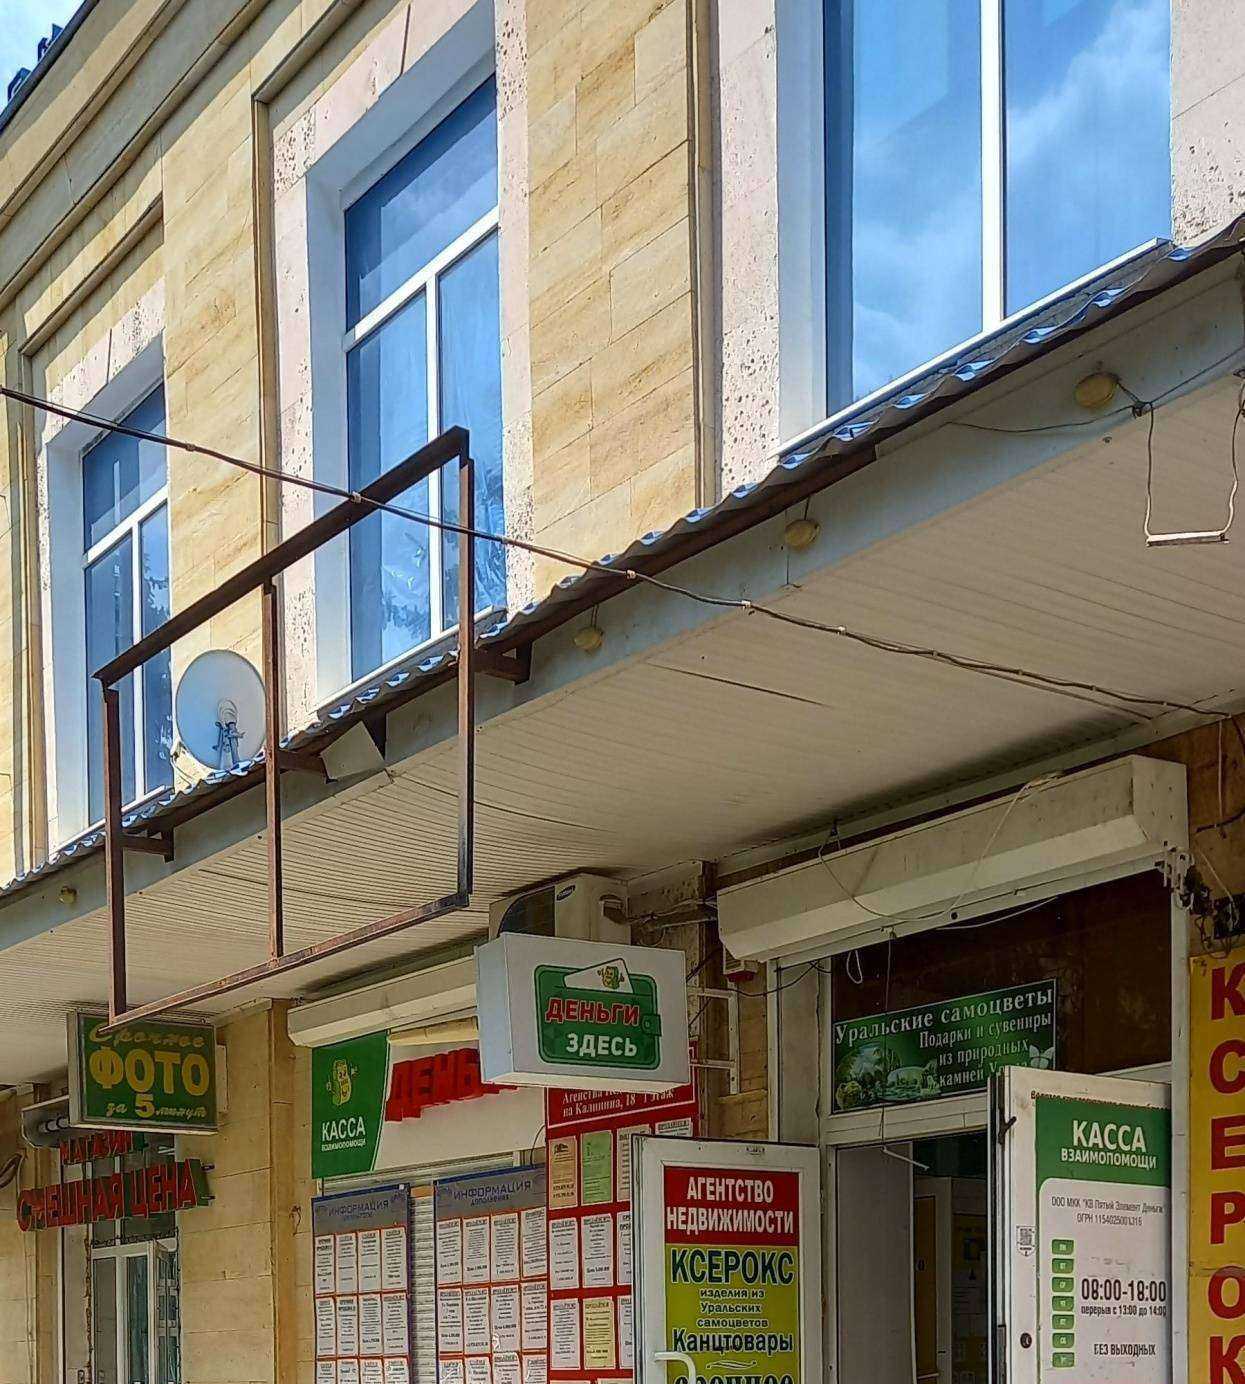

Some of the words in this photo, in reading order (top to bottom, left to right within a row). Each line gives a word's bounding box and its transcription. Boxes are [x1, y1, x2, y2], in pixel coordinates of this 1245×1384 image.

[545, 997, 640, 1026] ДЕНЬГИ
[835, 1011, 934, 1047] Уральские
[940, 988, 1054, 1024] самоцветы
[919, 1026, 972, 1049] Подарки
[976, 1026, 984, 1038] и
[988, 1013, 1052, 1041] сувениры
[566, 1033, 638, 1057] ЗДЕСЬ
[939, 1053, 954, 1067] из
[957, 1039, 1030, 1065] природных
[88, 1046, 210, 1096] ФОТО
[939, 1064, 984, 1089] камней
[384, 1047, 518, 1122] ДЕНЬ
[134, 1094, 155, 1118] 5
[155, 1104, 207, 1122] минут
[626, 1092, 636, 1104] 18
[321, 1116, 366, 1142] КАССА
[1073, 1119, 1147, 1153] КАССА
[1061, 1148, 1157, 1171] ВЗАИМОПОМОЩИ
[17, 1173, 125, 1232] СМЕШНАЯ
[130, 1159, 199, 1218] ЦЕНА
[453, 1180, 532, 1200] ИНФОРМАЦИЯ
[687, 1176, 774, 1203] АГЕНТСТВО
[1051, 1196, 1065, 1207] ООО
[328, 1200, 390, 1217] ИНФОРМАЦИЯ
[667, 1206, 794, 1235] НЕДВИЖИМОСТИ
[1076, 1212, 1094, 1223] ОГРН
[671, 1248, 794, 1285] КСЕРОКС
[700, 1289, 748, 1300] изделия
[751, 1289, 765, 1299] из
[1081, 1278, 1167, 1302] 08:00-18:00
[700, 1302, 762, 1315] Уральских
[1080, 1305, 1112, 1317] перерыв
[1113, 1307, 1117, 1315] с
[1119, 1305, 1138, 1316] 13:00
[1139, 1307, 1148, 1317] до
[1149, 1305, 1167, 1317] 14:00
[697, 1318, 769, 1329] самоцветов
[672, 1328, 793, 1356] Канцтовары
[1093, 1343, 1109, 1355] БЕЗ
[1110, 1343, 1156, 1357] ВЫХОДНЫХ
